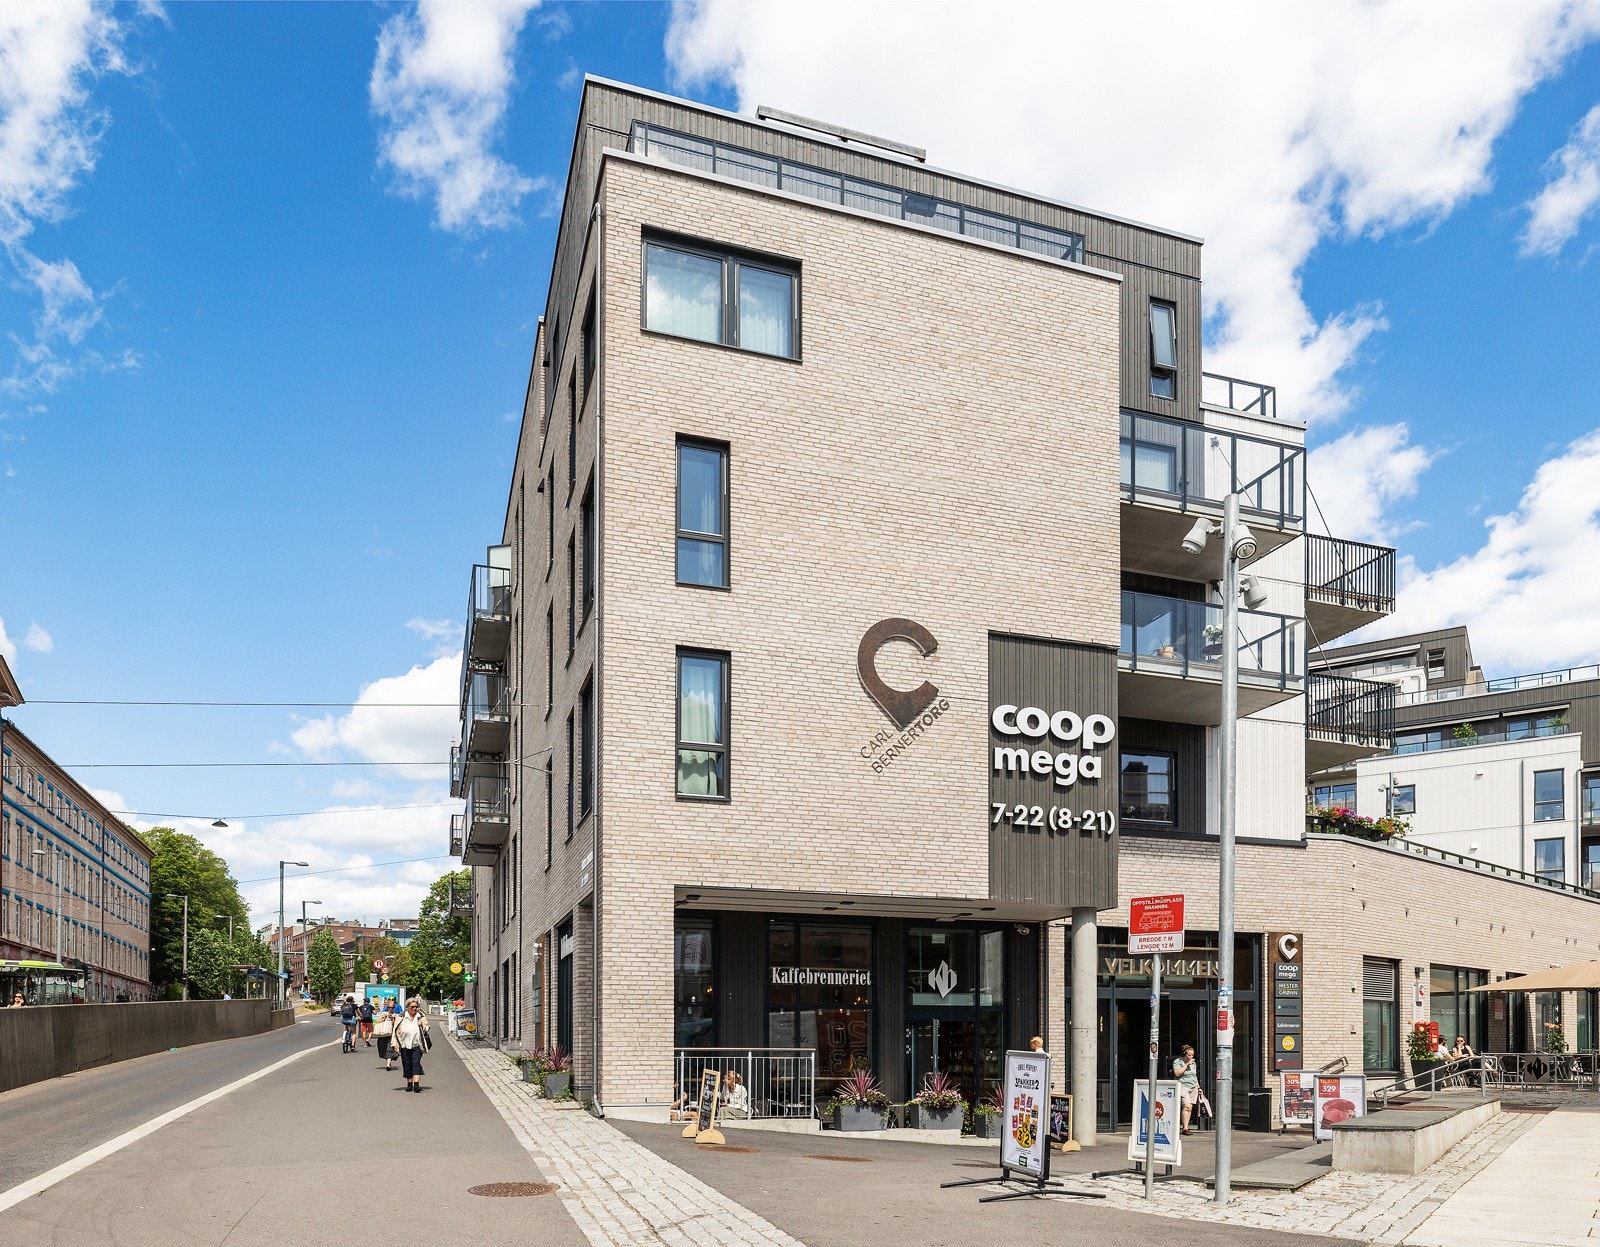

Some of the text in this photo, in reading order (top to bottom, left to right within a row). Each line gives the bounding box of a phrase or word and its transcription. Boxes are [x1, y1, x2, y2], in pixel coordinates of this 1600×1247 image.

[870, 697, 951, 775] BERNERTORG
[992, 704, 1116, 750] coop
[860, 728, 894, 760] CARL
[994, 746, 1102, 787] mega
[992, 802, 1116, 835] 7-22 (8-21)
[1132, 897, 1182, 906] OPPSTILLINGSPLASS
[772, 967, 872, 986] Kaffebrenneriet
[1278, 965, 1299, 973] coop
[1278, 971, 1297, 979] mega
[1322, 1085, 1337, 1093] 329
